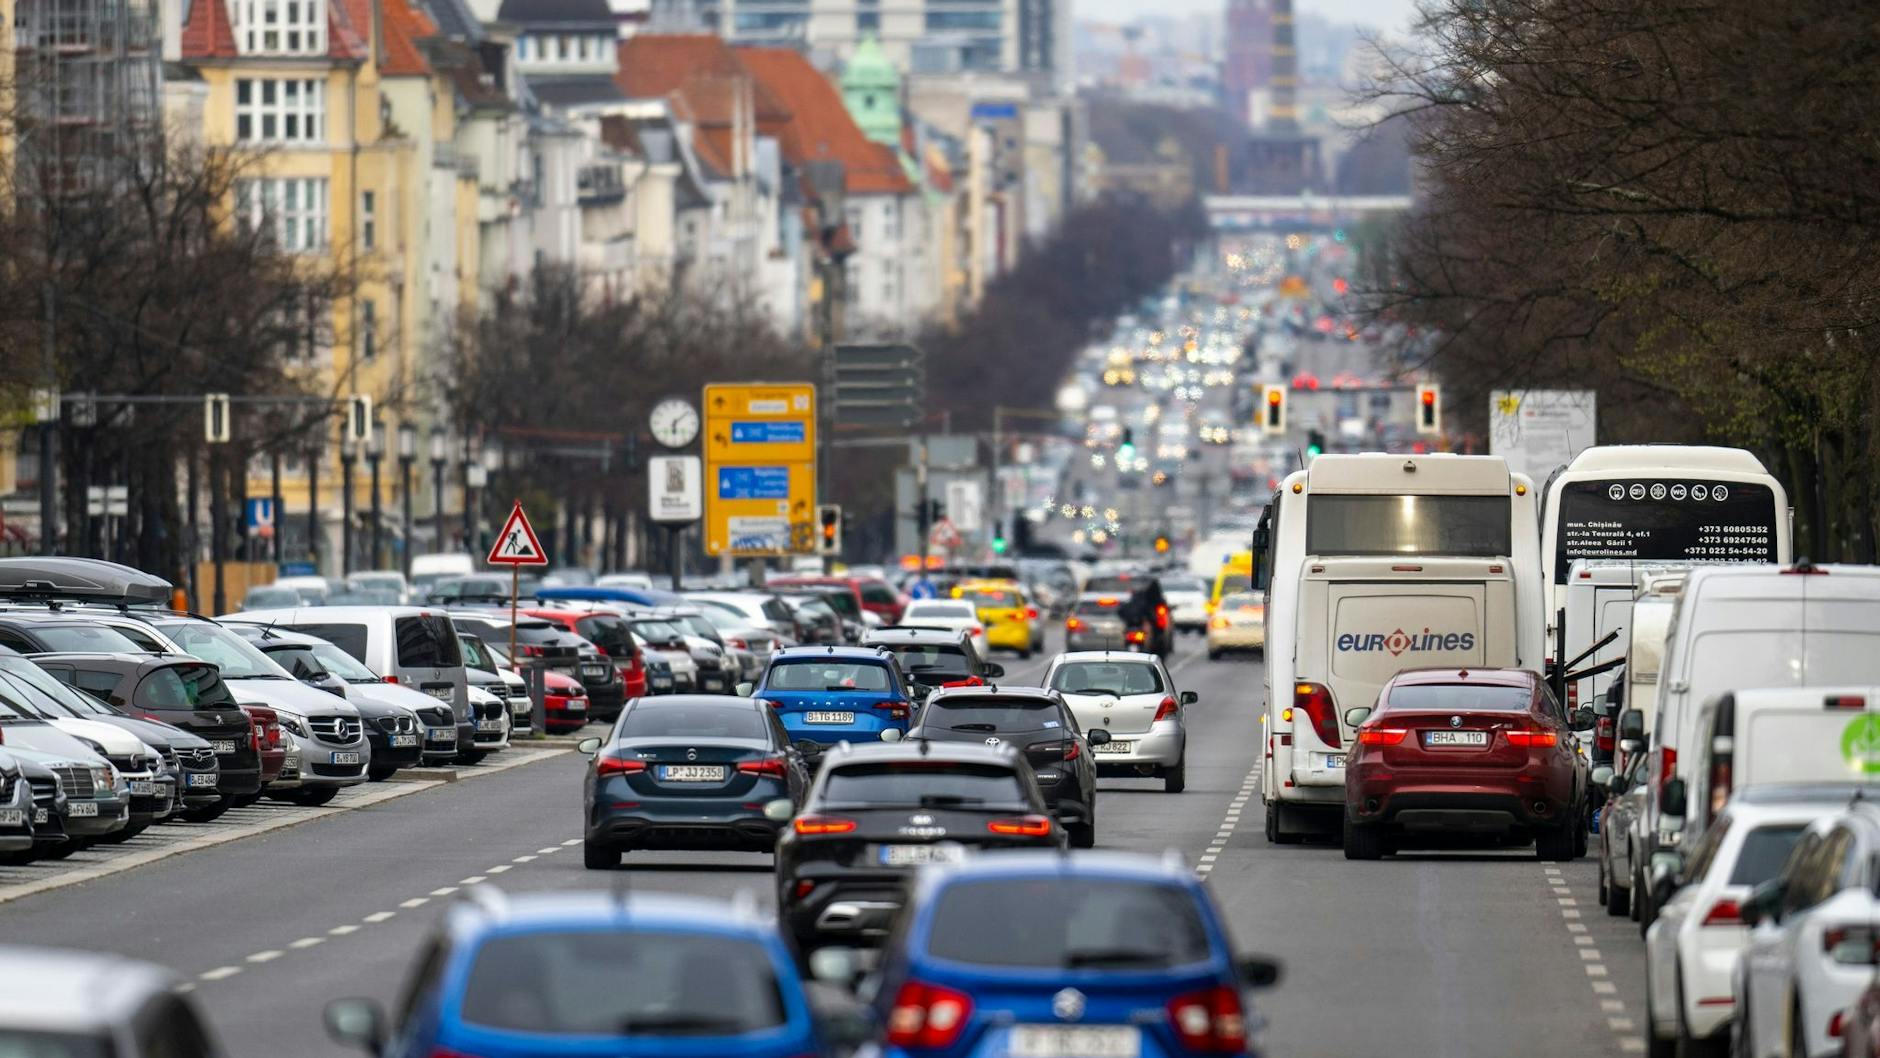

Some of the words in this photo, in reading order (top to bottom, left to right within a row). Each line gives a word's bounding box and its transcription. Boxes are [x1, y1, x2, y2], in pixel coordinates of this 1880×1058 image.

[1673, 488, 1684, 496] WC
[1723, 525, 1768, 533] 60805352
[1723, 536, 1768, 544] 69247540
[832, 712, 853, 722] 1189
[1433, 733, 1457, 743] BHA
[1466, 733, 1482, 743] 110
[1113, 742, 1127, 751] 822
[666, 767, 679, 777] LP
[685, 767, 697, 778] JJ
[700, 767, 722, 778] 2358
